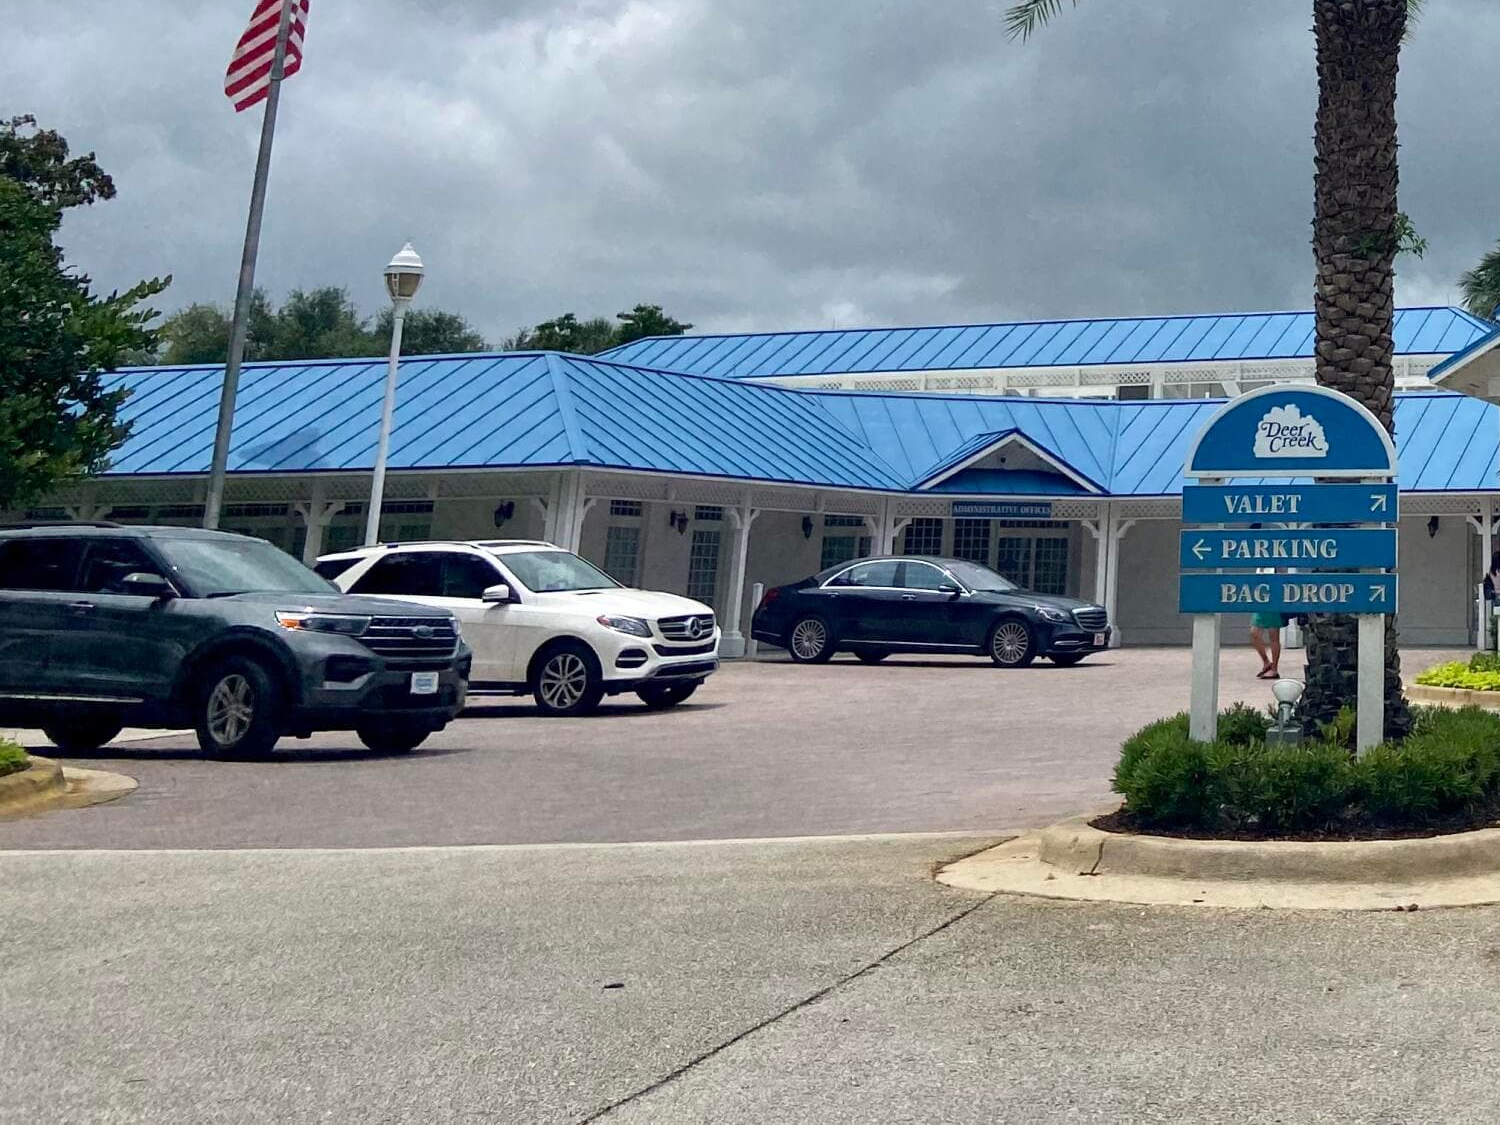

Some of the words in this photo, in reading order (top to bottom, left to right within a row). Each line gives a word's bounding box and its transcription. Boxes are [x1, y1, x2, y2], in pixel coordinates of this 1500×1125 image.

[1261, 422, 1310, 437] Deer
[1270, 432, 1322, 452] Creek
[953, 505, 1018, 513] ADMINISTRATIVE
[1020, 506, 1050, 514] OFFICES
[1224, 495, 1301, 513] VALET
[1221, 539, 1338, 559] PARKING
[1220, 584, 1271, 603] BAG
[1283, 584, 1355, 603] DROP
